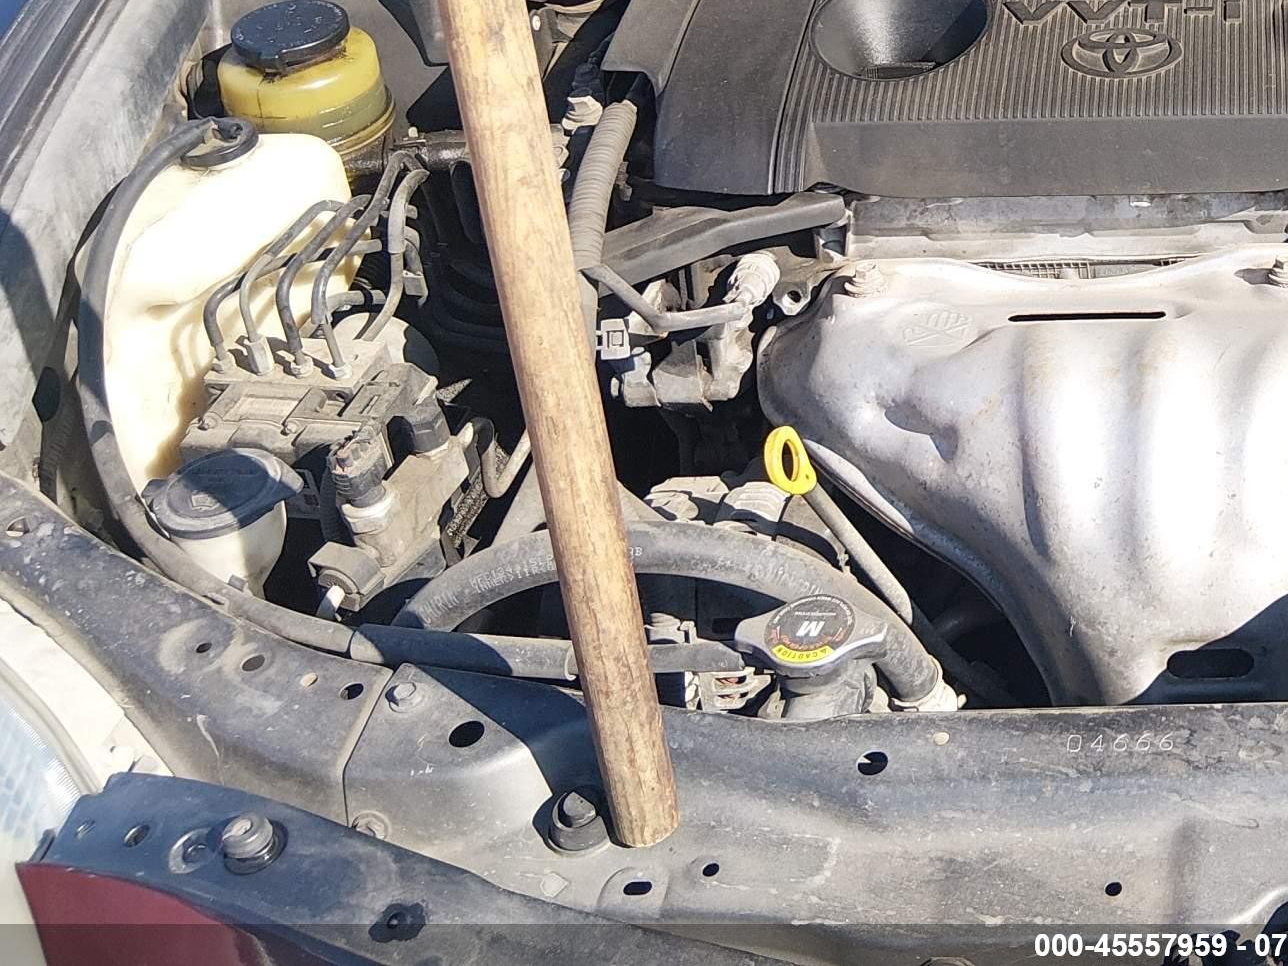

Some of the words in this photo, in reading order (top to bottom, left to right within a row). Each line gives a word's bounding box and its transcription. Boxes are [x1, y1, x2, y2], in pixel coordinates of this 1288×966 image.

[795, 620, 827, 639] M
[774, 647, 819, 661] CAUTION
[1065, 731, 1174, 753] 04666
